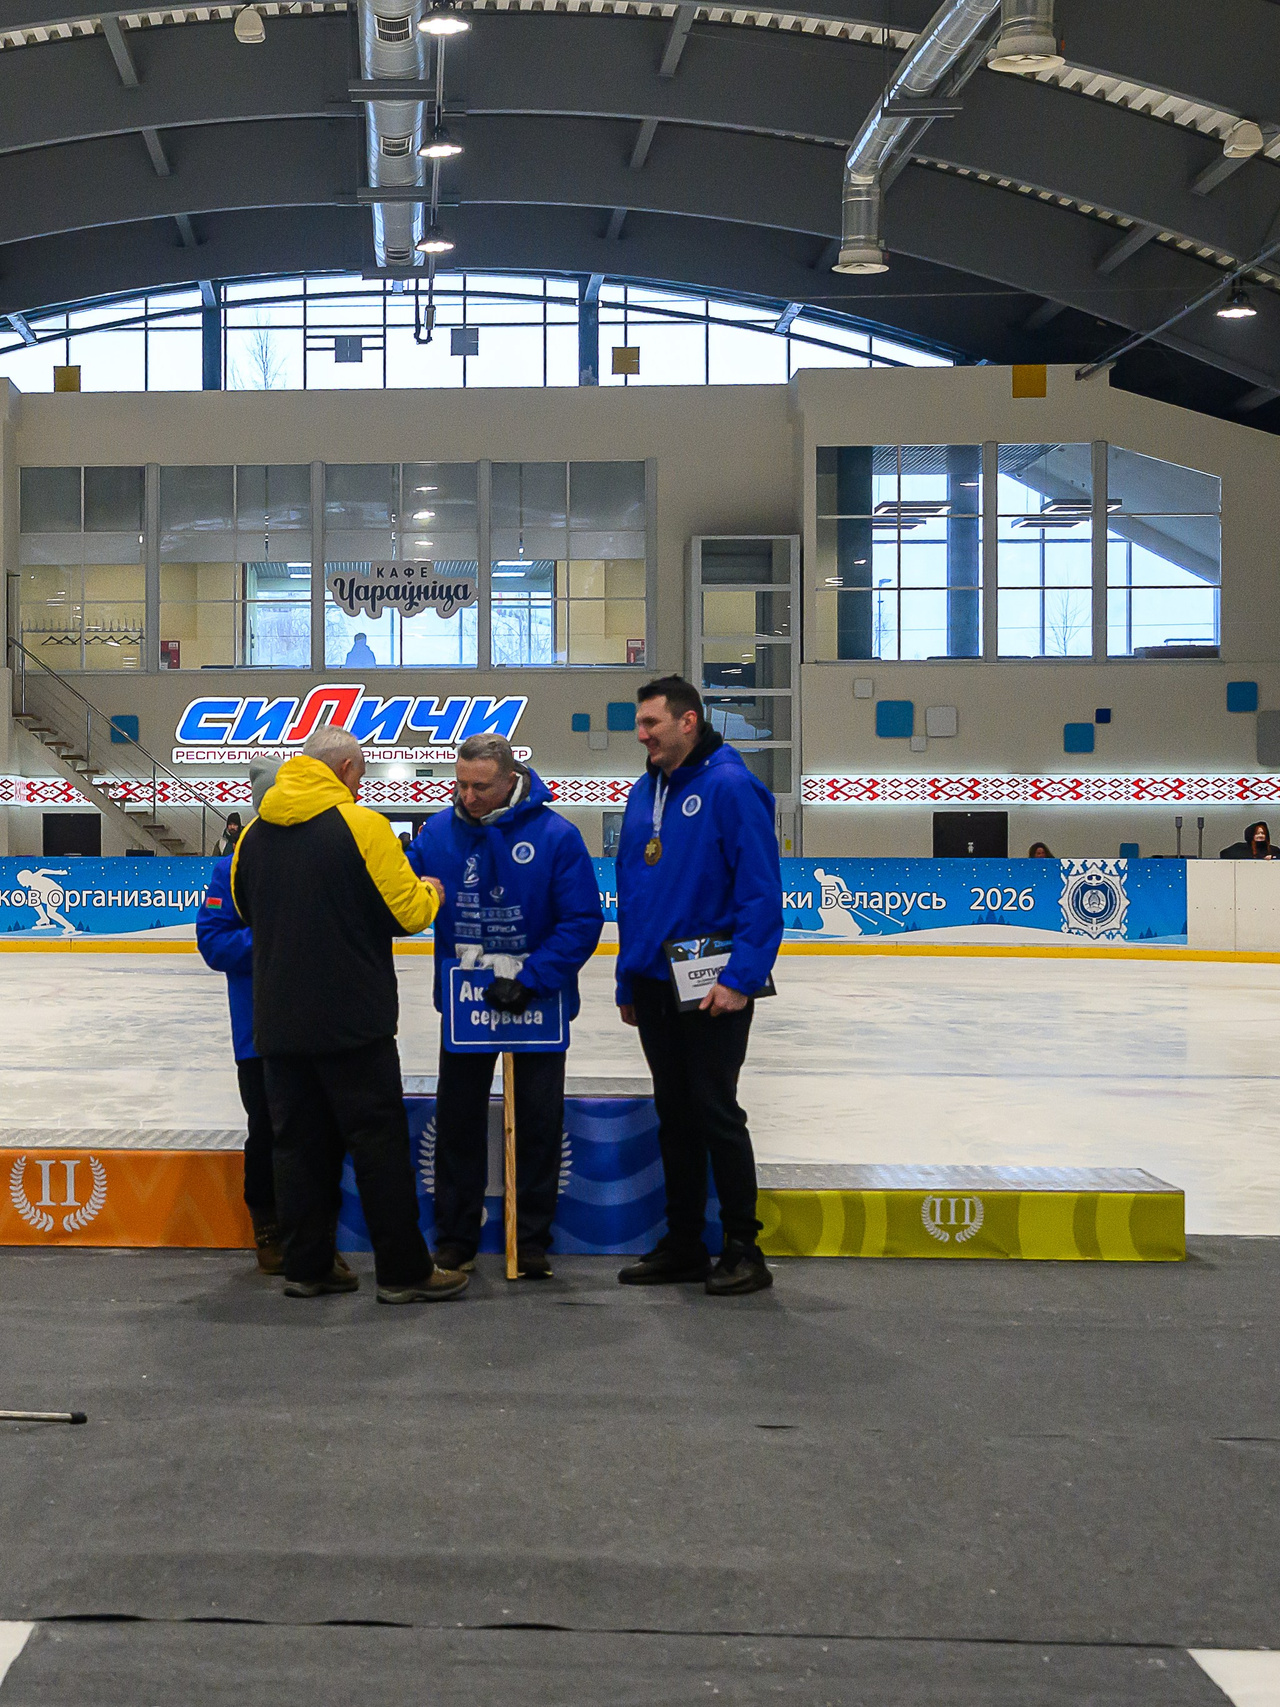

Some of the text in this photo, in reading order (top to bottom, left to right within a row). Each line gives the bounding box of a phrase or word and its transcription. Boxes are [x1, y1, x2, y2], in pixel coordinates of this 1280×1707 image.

[376, 566, 428, 578] КАФЕ
[176, 750, 304, 760] РЕСПУБЛИКАНС
[821, 886, 947, 915] Беларусь
[969, 887, 1035, 910] 2026
[688, 966, 726, 980] СЕРТИ
[35, 1160, 81, 1206] II
[932, 1198, 974, 1225] III
